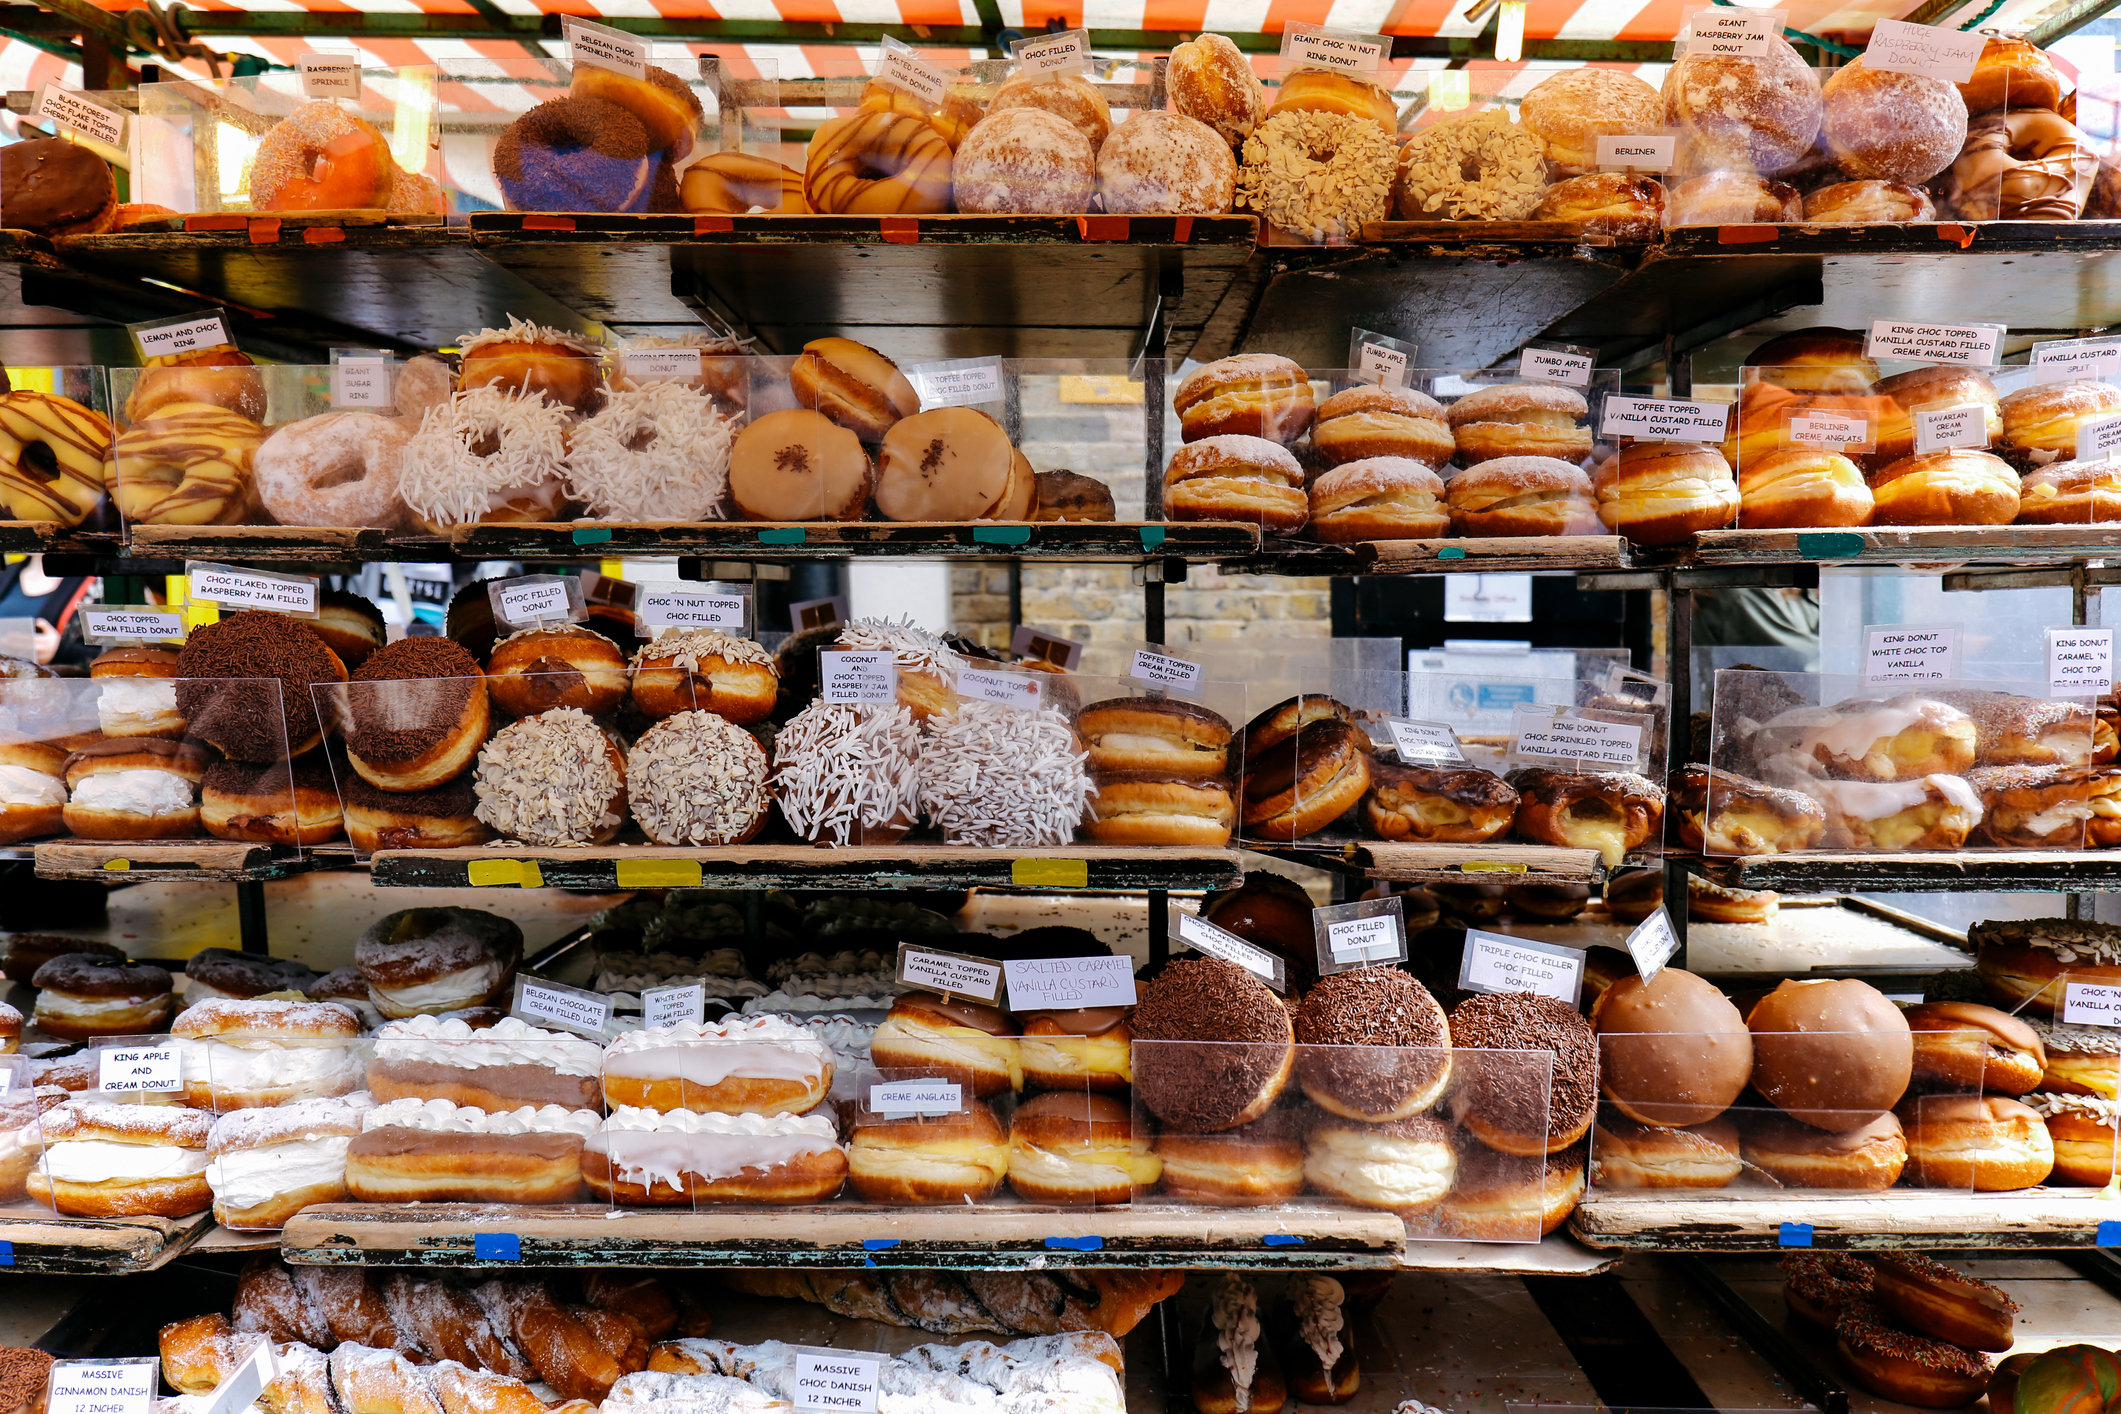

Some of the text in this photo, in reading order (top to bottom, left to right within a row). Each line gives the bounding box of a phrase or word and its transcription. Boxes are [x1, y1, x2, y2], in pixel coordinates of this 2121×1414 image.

[1718, 19, 1747, 27] GIANT
[1695, 31, 1764, 41] RASPBERRY JAM
[581, 35, 635, 58] BELGIAN CHOC
[1293, 33, 1376, 55] GIANT CHOC NUT
[1712, 44, 1743, 53] DONUT
[1025, 44, 1076, 60] CHOC FILLED
[1040, 56, 1068, 68] DONUT
[1306, 50, 1358, 67] RING DONUT
[887, 54, 943, 88] SALTED CARAMEL
[311, 78, 349, 86] SPRINKLE
[890, 69, 934, 95] RING DONUT
[58, 94, 110, 122] BLACK FOREST
[46, 98, 118, 136] CHOC FLAKE TOPPED
[42, 107, 115, 144] CHERRY JAM FILLED
[143, 323, 219, 343] LEMON AND CHOC
[1891, 326, 1977, 339] KING CHOC TOPPED
[173, 339, 196, 348] RING
[1875, 335, 1990, 351] VANILLA CUSTARD FILLED
[1891, 347, 1969, 359] CREME ANGLAISE
[2043, 350, 2117, 363] VANILLA CUSTARD
[1534, 356, 1587, 370] JUMBO APPLE
[1547, 369, 1570, 378] SPLIT
[1632, 402, 1700, 415] TOFFEE TOPPED
[1650, 416, 1723, 428] CUSTARD FILLED
[1929, 412, 1968, 422] BAVARIAN
[1649, 426, 1680, 435] DONUT
[1809, 422, 1849, 431] BERLINER
[1936, 422, 1961, 430] CREAM
[1795, 433, 1822, 441] CREME
[1936, 430, 1963, 439] DONUT
[206, 575, 304, 594] CHOC FLAKED TOPPED
[201, 586, 308, 605] RASPBERRY JAM FILLED
[505, 588, 561, 605] CHOC FILLED
[522, 600, 553, 613] DONUT
[647, 598, 740, 609] CHOC NUT TOPPED
[106, 615, 159, 623] CHOC TOPPED
[666, 613, 721, 622] CHOC FILLED
[120, 625, 147, 633] FILLED
[149, 626, 178, 634] DONUT
[1883, 633, 1938, 643] KING DONUT
[2056, 639, 2108, 648] KING DONUT
[1872, 646, 1948, 656] WHITE CHOC TOP
[2057, 652, 2094, 660] CARAMEL
[1138, 652, 1195, 672] TOFFEE TOPPED
[1887, 660, 1924, 668] VANILLA
[1138, 661, 1190, 679] CREAM FILLED
[2061, 666, 2083, 674] CHOC
[963, 673, 1004, 686] COCONUT
[984, 688, 1015, 700] DONUT
[1551, 722, 1607, 733] KING DONUT
[1524, 732, 1632, 749] CHOC SPRINKLED TOPPED
[1520, 745, 1633, 762] VANILLA CUSTARD FILLED
[1333, 921, 1385, 935] CHOC FILLED
[1347, 934, 1376, 946] DONUT
[1479, 945, 1573, 970] TRIPLE CHOC KILLER
[912, 956, 990, 976] CARAMEL TOPPED
[1015, 959, 1131, 974] SALTED CARAMEL
[1493, 961, 1553, 979] CHOC FILLED
[909, 964, 991, 985] VANILLA CUSTARD
[932, 977, 963, 989] FILLED
[1012, 972, 1119, 993] VANILLA CUSTARD
[1505, 977, 1538, 990] DONUT
[676, 991, 693, 999] CHOC
[1043, 989, 1082, 1002] FILLED
[2081, 988, 2106, 997] CHOC
[526, 988, 602, 1016] BELGIAN CHOCOLATE
[663, 1002, 684, 1010] TOPPED
[2070, 1000, 2110, 1010] VANILLA
[530, 1001, 598, 1027] CREAM FILLED LOG
[673, 1008, 694, 1017] FILLED
[114, 1052, 170, 1062] KING APPLE
[131, 1067, 152, 1075] AND
[105, 1080, 176, 1090] CREAM DONUT
[881, 1093, 957, 1101] CREME ANGLAIS
[82, 1370, 123, 1379] MASSIVE
[813, 1364, 860, 1376] MASSIVE
[800, 1378, 871, 1392] CHOC DANISH
[54, 1387, 148, 1396] CINNAMON DANISH
[807, 1394, 861, 1407] 12 INCHER
[89, 1404, 124, 1413] INCHER
